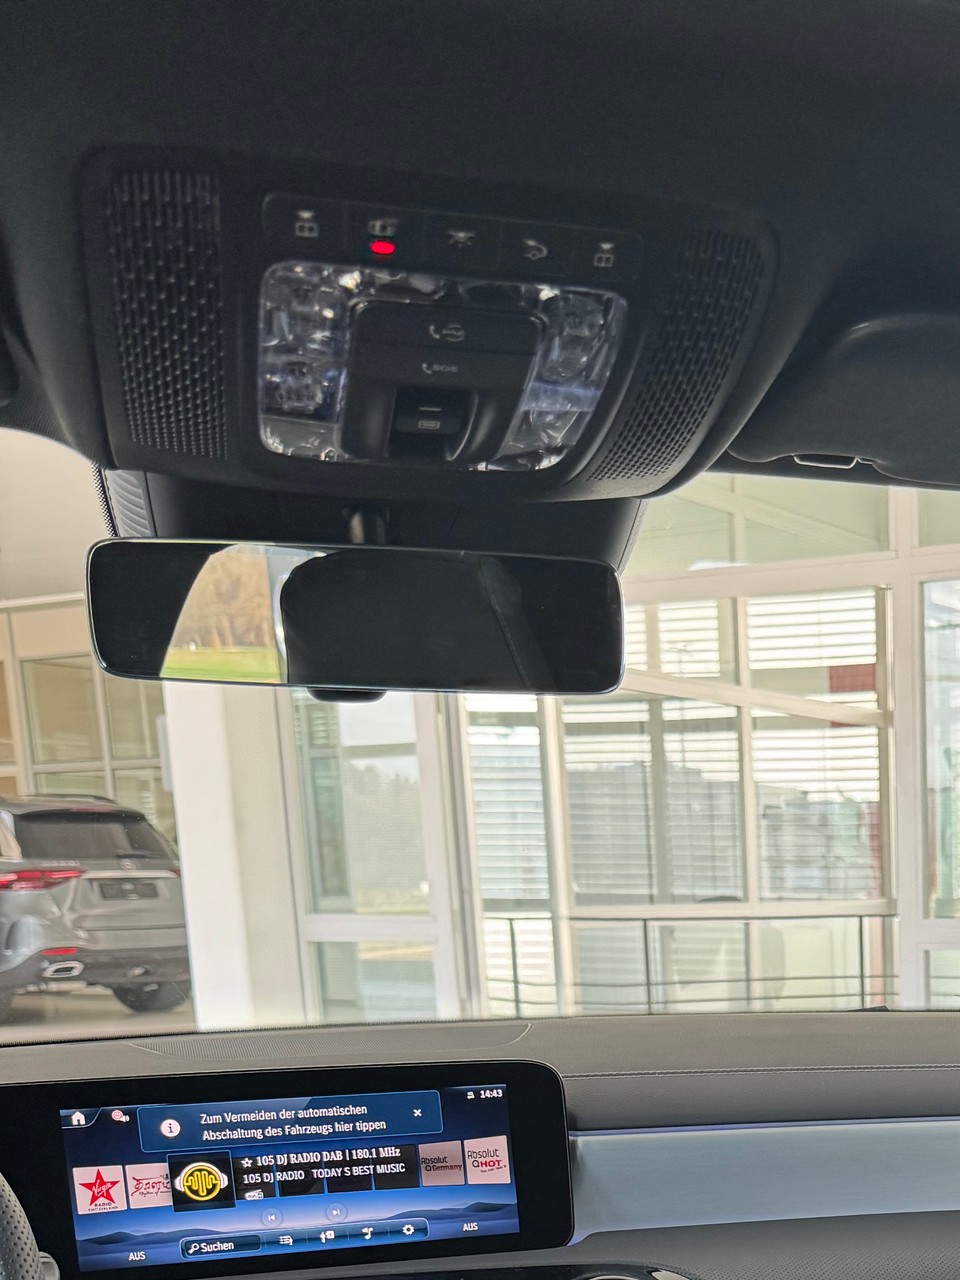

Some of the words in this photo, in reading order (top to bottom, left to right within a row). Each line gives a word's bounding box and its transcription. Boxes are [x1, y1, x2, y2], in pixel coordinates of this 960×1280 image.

[480, 1089, 503, 1099] 14:43
[200, 1113, 222, 1125] Zum
[225, 1110, 277, 1123] Vermeiden
[279, 1109, 295, 1120] der
[297, 1105, 368, 1118] automatischen
[203, 1127, 264, 1142] Abschaltung
[266, 1125, 283, 1137] des
[285, 1122, 333, 1136] Fahrzeugs
[335, 1121, 353, 1133] hier
[356, 1120, 387, 1133] tippen
[256, 1155, 275, 1167] 105
[276, 1154, 288, 1166] DJ
[290, 1152, 321, 1164] RADIO
[323, 1150, 343, 1162] DAB
[351, 1147, 378, 1160] 180.1
[379, 1146, 401, 1158] MHz
[467, 1148, 500, 1160] Absolut
[421, 1155, 448, 1165] Absolut
[480, 1159, 502, 1168] HOT
[243, 1173, 261, 1185] 105
[263, 1172, 275, 1184] DJ
[276, 1169, 305, 1182] RADIO
[312, 1167, 342, 1179] TODAY
[344, 1166, 351, 1177] S
[352, 1164, 374, 1176] BEST
[376, 1162, 406, 1175] MUSIC
[432, 1164, 463, 1172] Germany
[463, 1222, 479, 1232] AUS
[201, 1240, 235, 1253] Suchen
[128, 1251, 146, 1261] AUS
